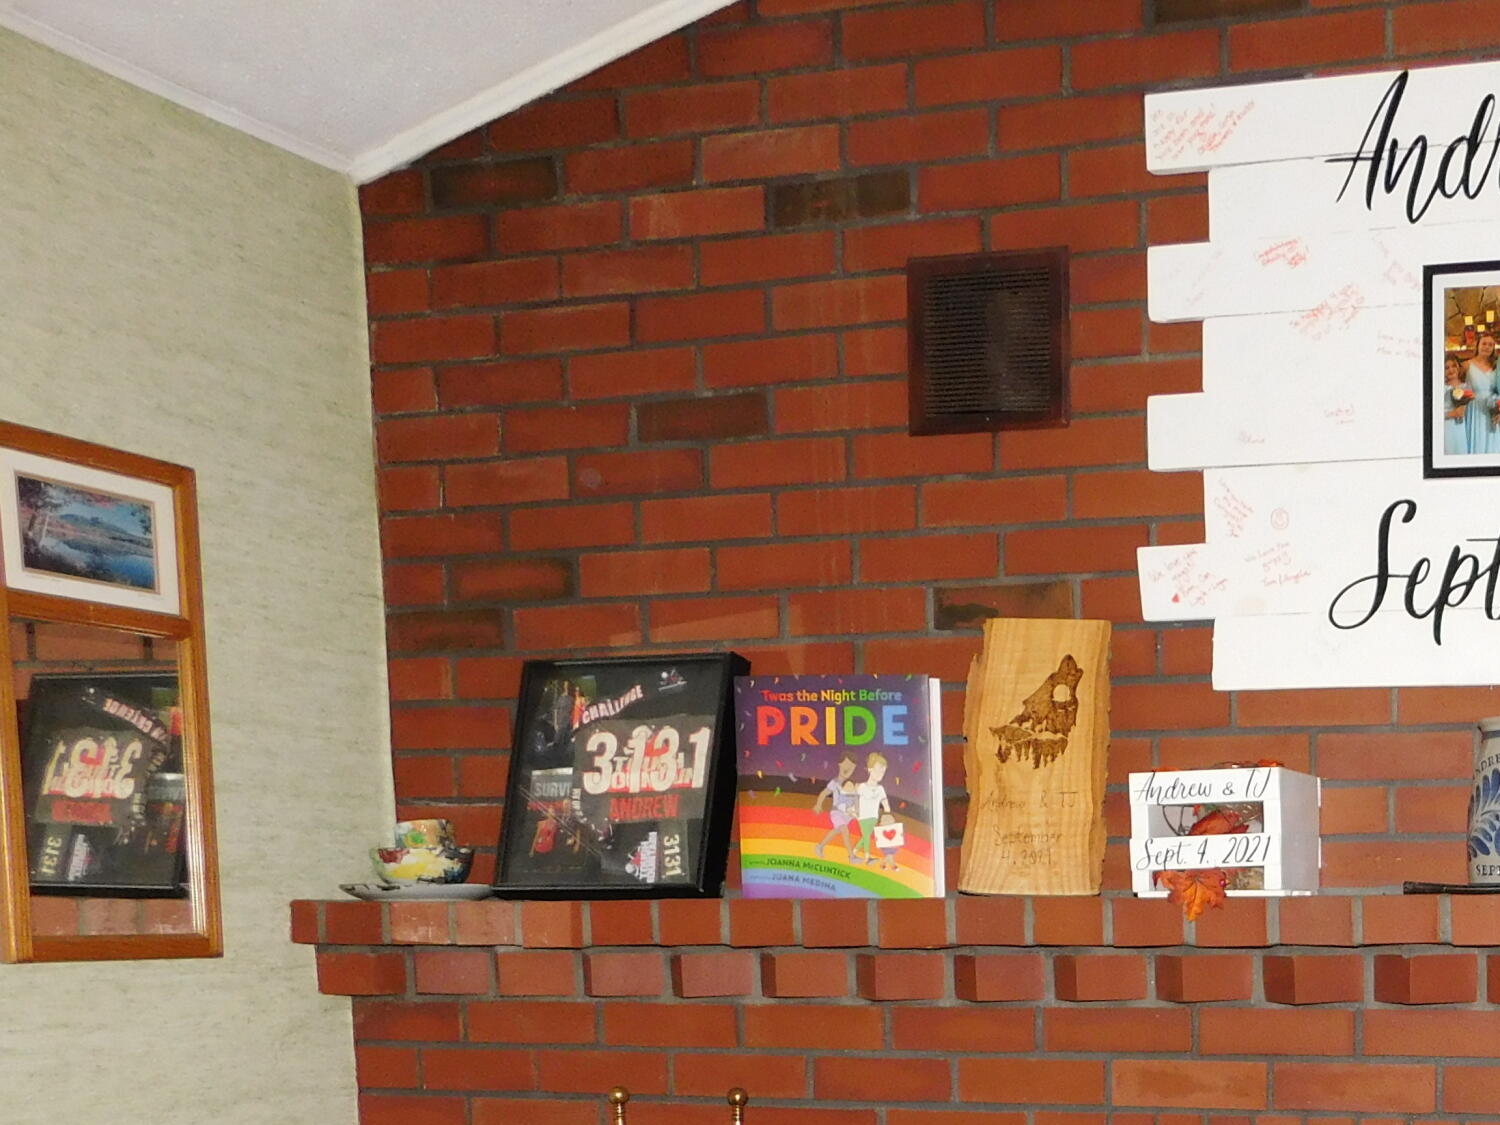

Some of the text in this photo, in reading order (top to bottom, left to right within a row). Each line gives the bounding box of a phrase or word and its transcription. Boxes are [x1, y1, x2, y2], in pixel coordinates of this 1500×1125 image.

[796, 690, 818, 702] the
[821, 689, 856, 705] Night
[859, 688, 903, 702] Before
[756, 704, 909, 746] PRIDE
[583, 726, 711, 795] 3131
[1134, 771, 1212, 806] Andrew
[1222, 782, 1235, 796] &
[609, 795, 681, 819] ANDREW
[663, 834, 682, 876] 3131
[1222, 835, 1271, 864] 2021
